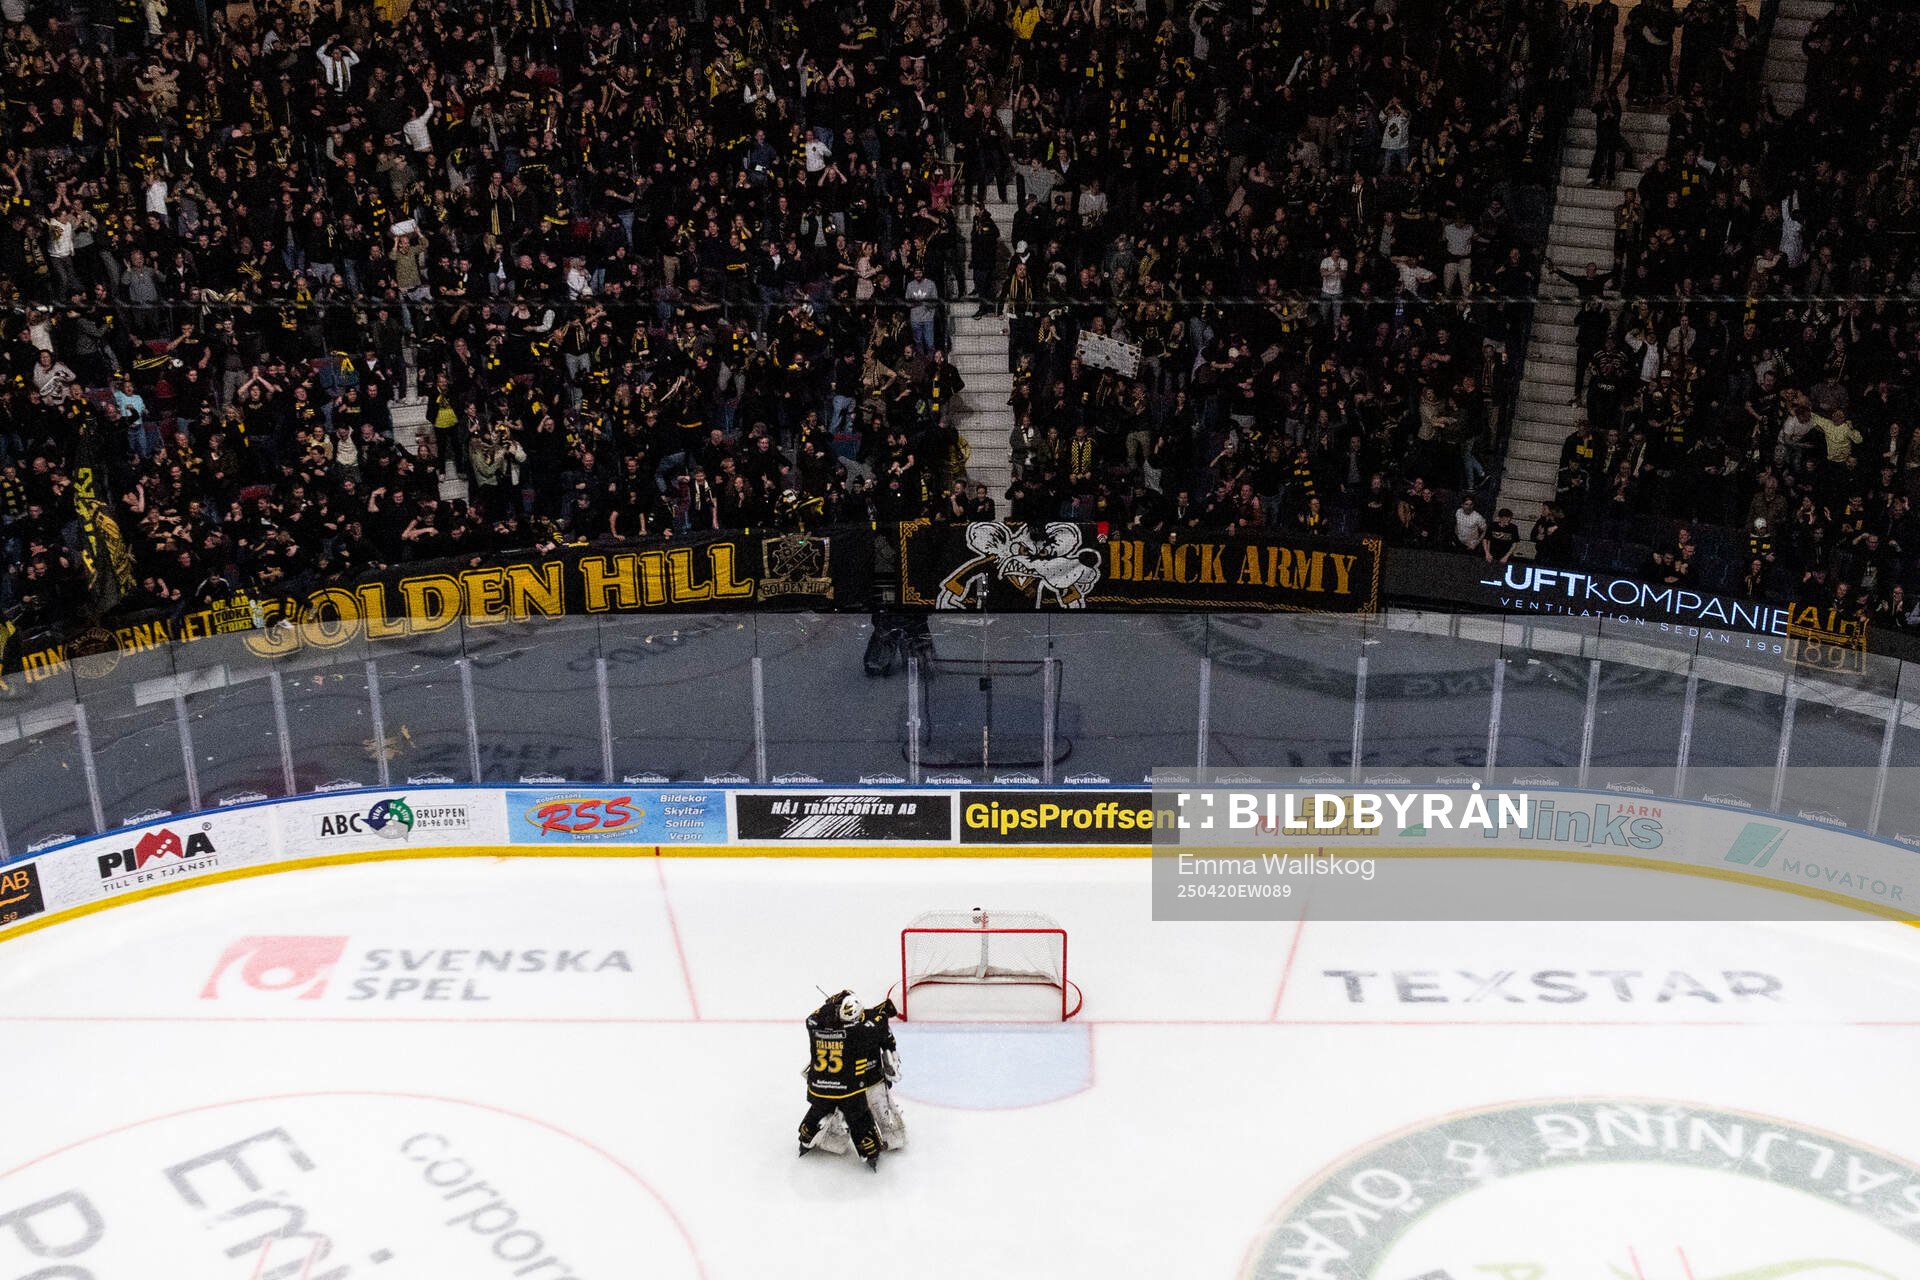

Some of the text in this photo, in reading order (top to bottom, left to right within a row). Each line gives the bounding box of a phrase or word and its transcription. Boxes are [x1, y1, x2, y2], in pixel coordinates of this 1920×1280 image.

[1109, 540, 1358, 595] BLACK ARMY
[242, 543, 754, 657] GOLDEN HILL
[763, 582, 803, 596] GOLDEN
[214, 607, 251, 624] VODKA
[1500, 598, 1645, 626] VENTILATION
[1659, 622, 1731, 645] SEDAN
[993, 776, 1040, 784] Ångtvättbilen
[1064, 776, 1110, 784] Ångtvättbilen
[660, 794, 707, 802] Bildekor
[771, 799, 917, 815] HÅJ TRANSPORTER AB
[416, 807, 465, 819] GRUPPEN
[538, 797, 631, 836] RSS
[664, 807, 705, 816] Skyltar
[965, 801, 1175, 835] GipsProffsen
[1616, 803, 1662, 817] JÄRN
[321, 813, 362, 836] ABC
[666, 819, 705, 828] Solfilm
[669, 832, 703, 841] Vepor
[1, 870, 30, 895] AB
[103, 881, 131, 893] TILL
[138, 872, 154, 883] ER
[1782, 858, 1905, 901] MOVATOR
[359, 948, 634, 974] SVENSKA
[346, 977, 492, 1001] SPEL
[1322, 969, 1784, 1004] TEXSTAR
[814, 1050, 843, 1073] 35
